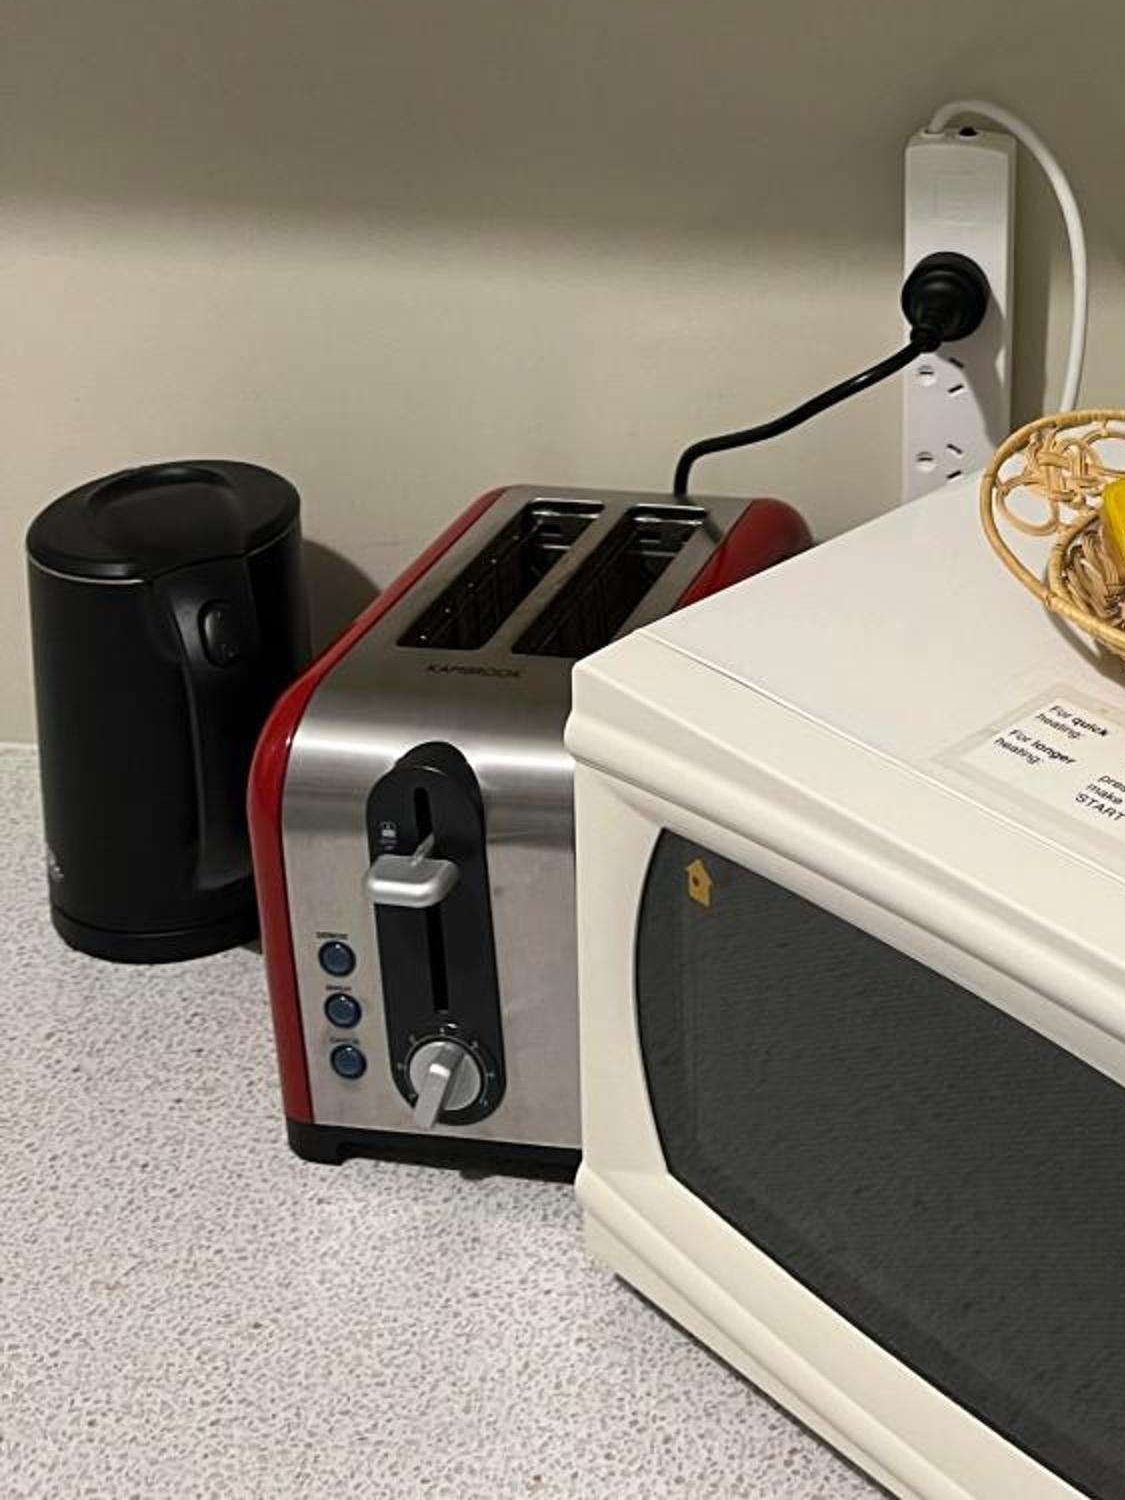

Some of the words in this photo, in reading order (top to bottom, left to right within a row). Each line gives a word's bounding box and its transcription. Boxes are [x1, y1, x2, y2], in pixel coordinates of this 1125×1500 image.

[1049, 705, 1072, 719] For
[1071, 717, 1107, 737] quick
[1008, 728, 1032, 743] For
[1030, 739, 1077, 764] longer
[1085, 782, 1125, 806] make
